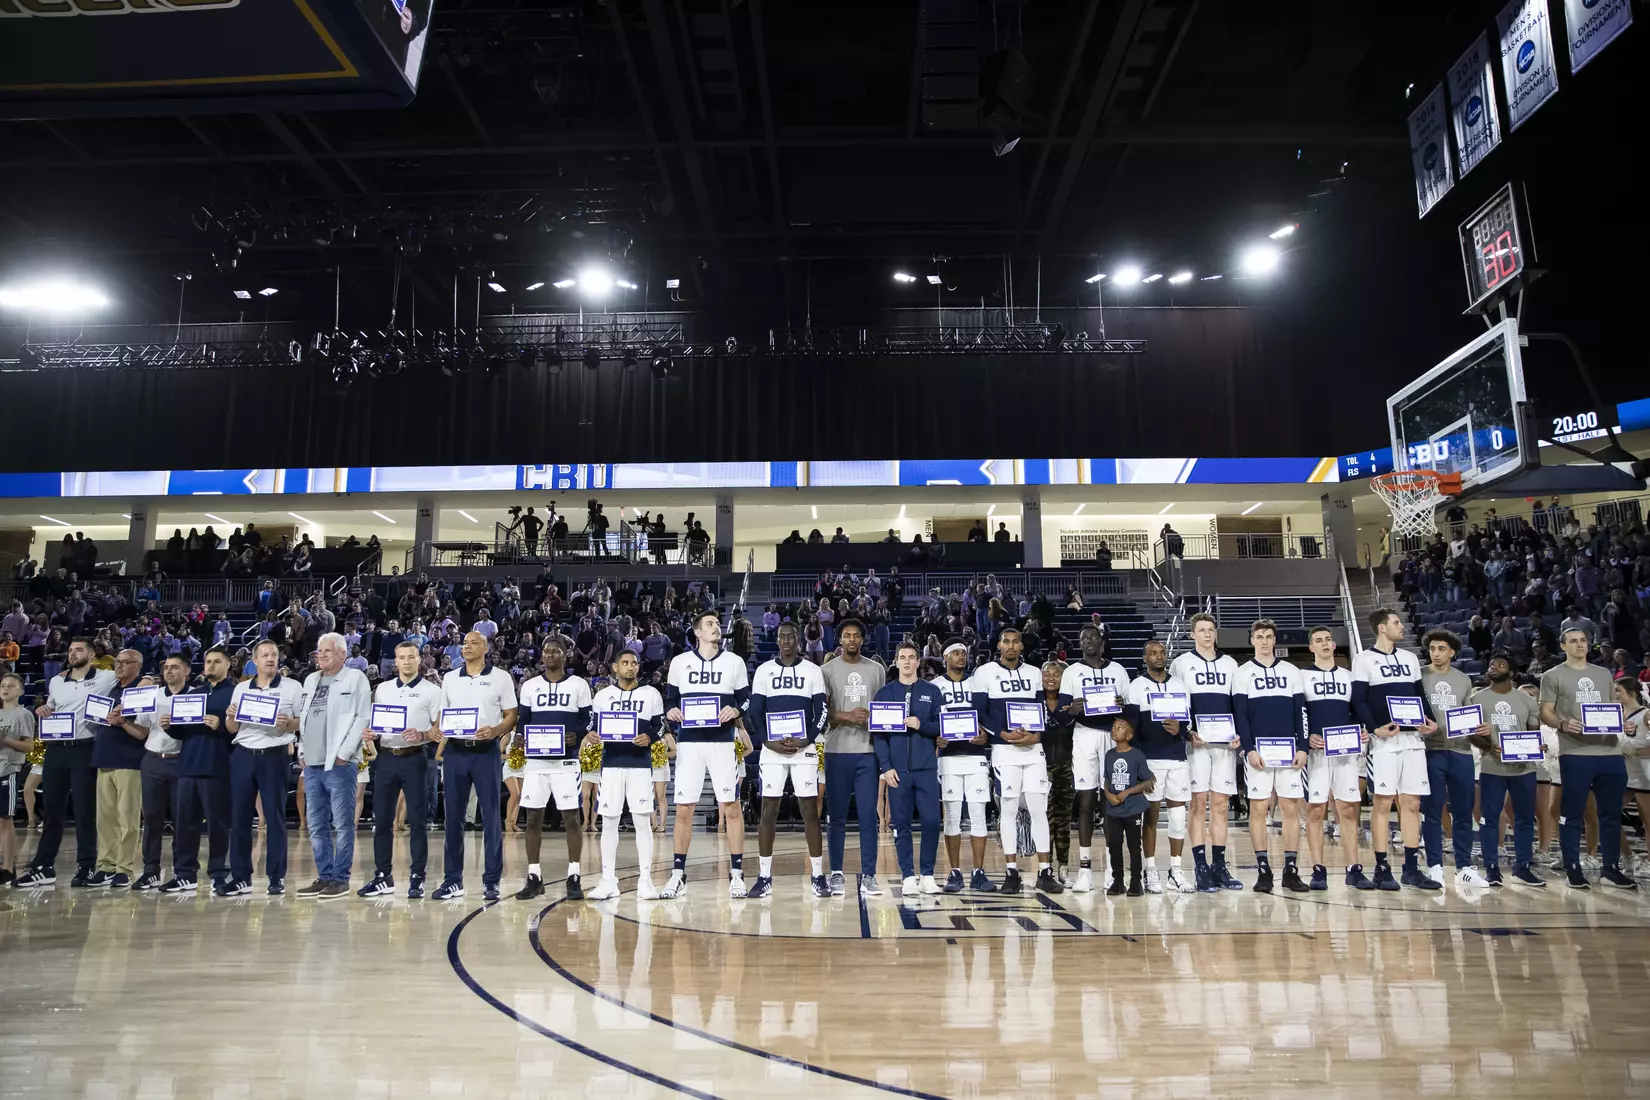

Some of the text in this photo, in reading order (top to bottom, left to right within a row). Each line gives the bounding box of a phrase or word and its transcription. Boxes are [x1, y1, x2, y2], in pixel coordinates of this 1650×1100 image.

[1510, 11, 1531, 37] MEN'S
[1501, 11, 1545, 57] BASKETBALL
[1513, 68, 1540, 98] DIVISION
[1553, 412, 1598, 435] 20:00
[1492, 430, 1503, 450] 0
[1346, 453, 1376, 466] TOL 4
[516, 464, 613, 490] CBU
[1347, 467, 1359, 476] FLS
[1209, 518, 1218, 550] WOMEN
[688, 671, 722, 685] CBU
[1379, 664, 1411, 678] CBU
[772, 676, 805, 690] CBU
[1000, 678, 1031, 693] CBU
[1195, 672, 1226, 686] CBU
[1254, 676, 1287, 690] CBU
[1313, 681, 1347, 696] CBU
[536, 693, 571, 707] CBU
[943, 691, 972, 704] CBU
[610, 700, 645, 713] CBU
[1301, 706, 1309, 740] LANCERS
